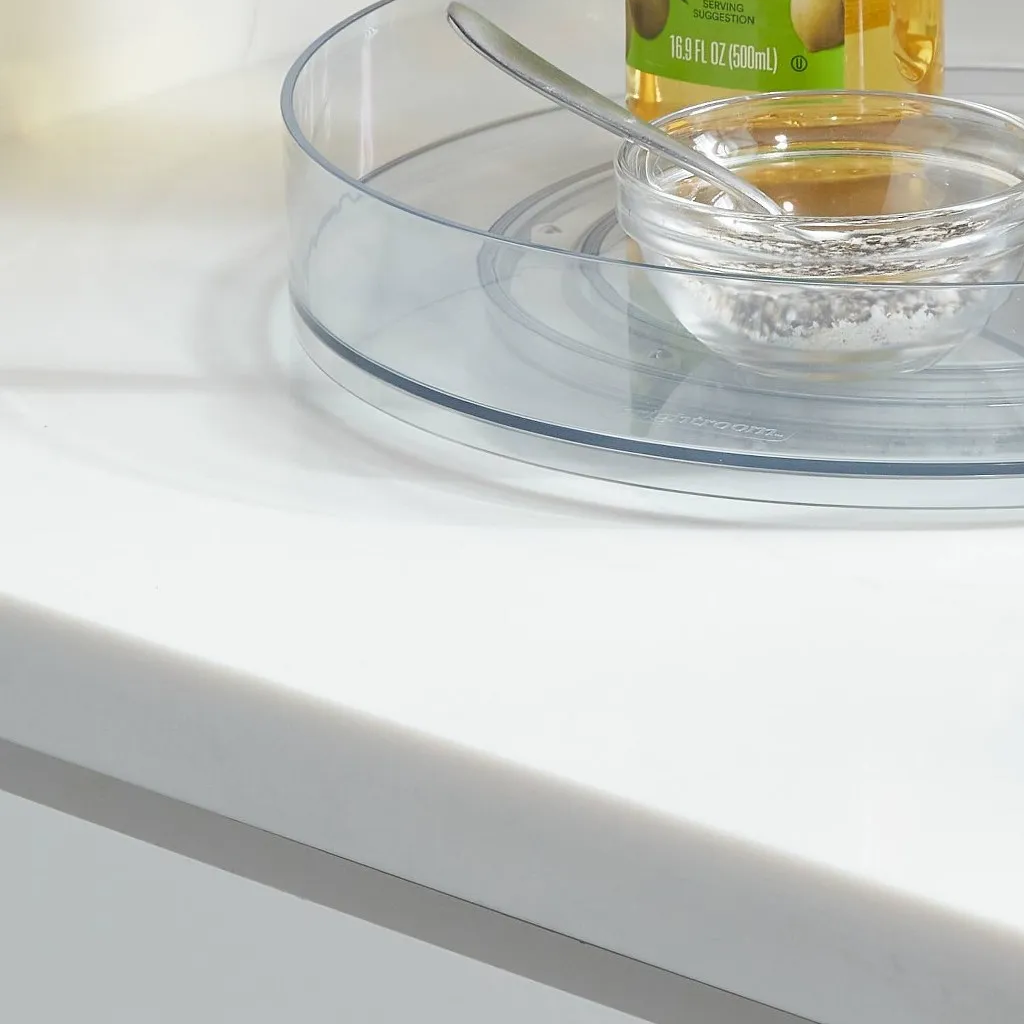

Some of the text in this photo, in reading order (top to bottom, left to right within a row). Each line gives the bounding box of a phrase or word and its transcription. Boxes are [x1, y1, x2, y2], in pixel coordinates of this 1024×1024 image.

[702, 0, 745, 13] SERVING
[692, 8, 756, 25] SUGGESTION
[669, 34, 778, 74] 16.9 FL OZ (500mL)
